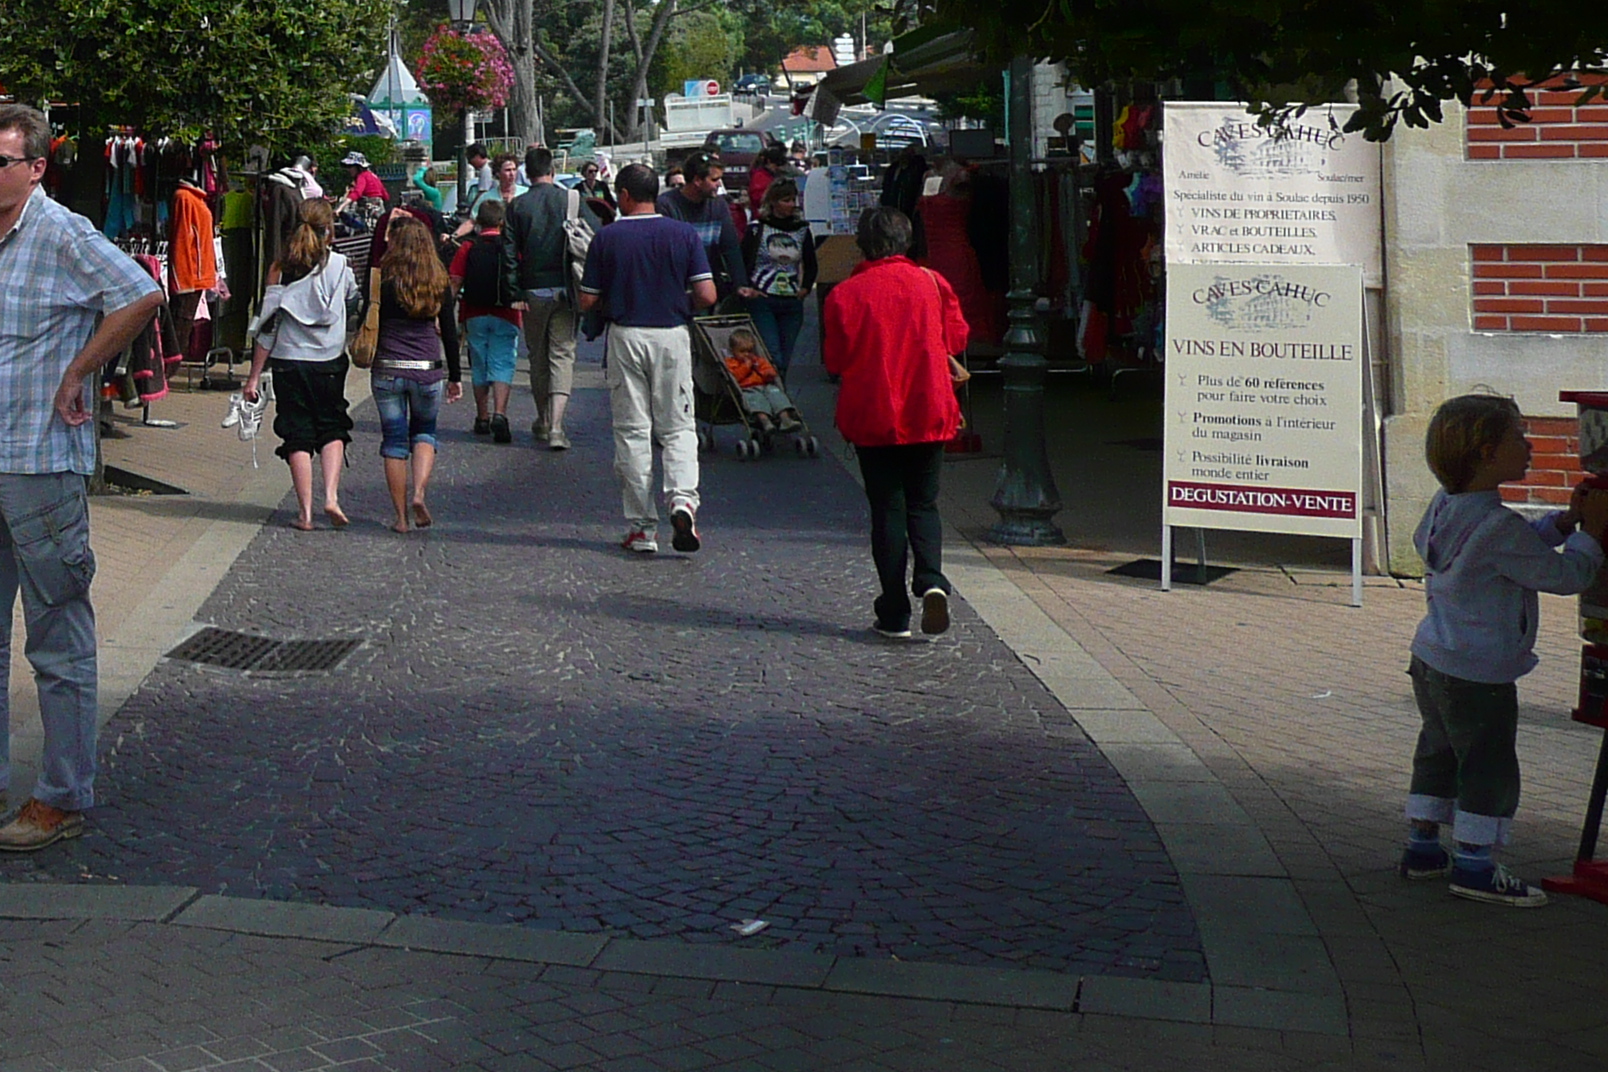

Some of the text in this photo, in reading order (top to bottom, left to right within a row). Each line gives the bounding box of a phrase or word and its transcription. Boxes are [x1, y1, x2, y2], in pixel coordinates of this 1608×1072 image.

[1198, 122, 1261, 147] CAVES
[1173, 189, 1227, 202] Spécialiste
[1230, 191, 1243, 201] du
[1248, 192, 1264, 201] vin
[1276, 192, 1309, 202] Soulac
[1312, 193, 1344, 205] depuis
[1347, 194, 1369, 204] 1950
[1191, 208, 1221, 218] VINS
[1224, 209, 1241, 219] DE
[1191, 225, 1227, 236] VRAC
[1229, 227, 1238, 236] et
[1191, 242, 1316, 255] ARTICLES CADEAUX.
[1192, 280, 1331, 307] CAVES CAHUC
[1172, 339, 1353, 360] VINS EN BOUTEILLE
[1198, 374, 1325, 391] Plus de 60 références
[1197, 391, 1327, 406] pour faire votre choix
[1193, 412, 1336, 430] Promotions à l'intérieur
[1192, 427, 1262, 442] du magasin
[1192, 450, 1309, 469] Possibilité livraison
[1192, 467, 1270, 481] monde entier
[1171, 486, 1353, 512] DEGUSTATION-VENTE
